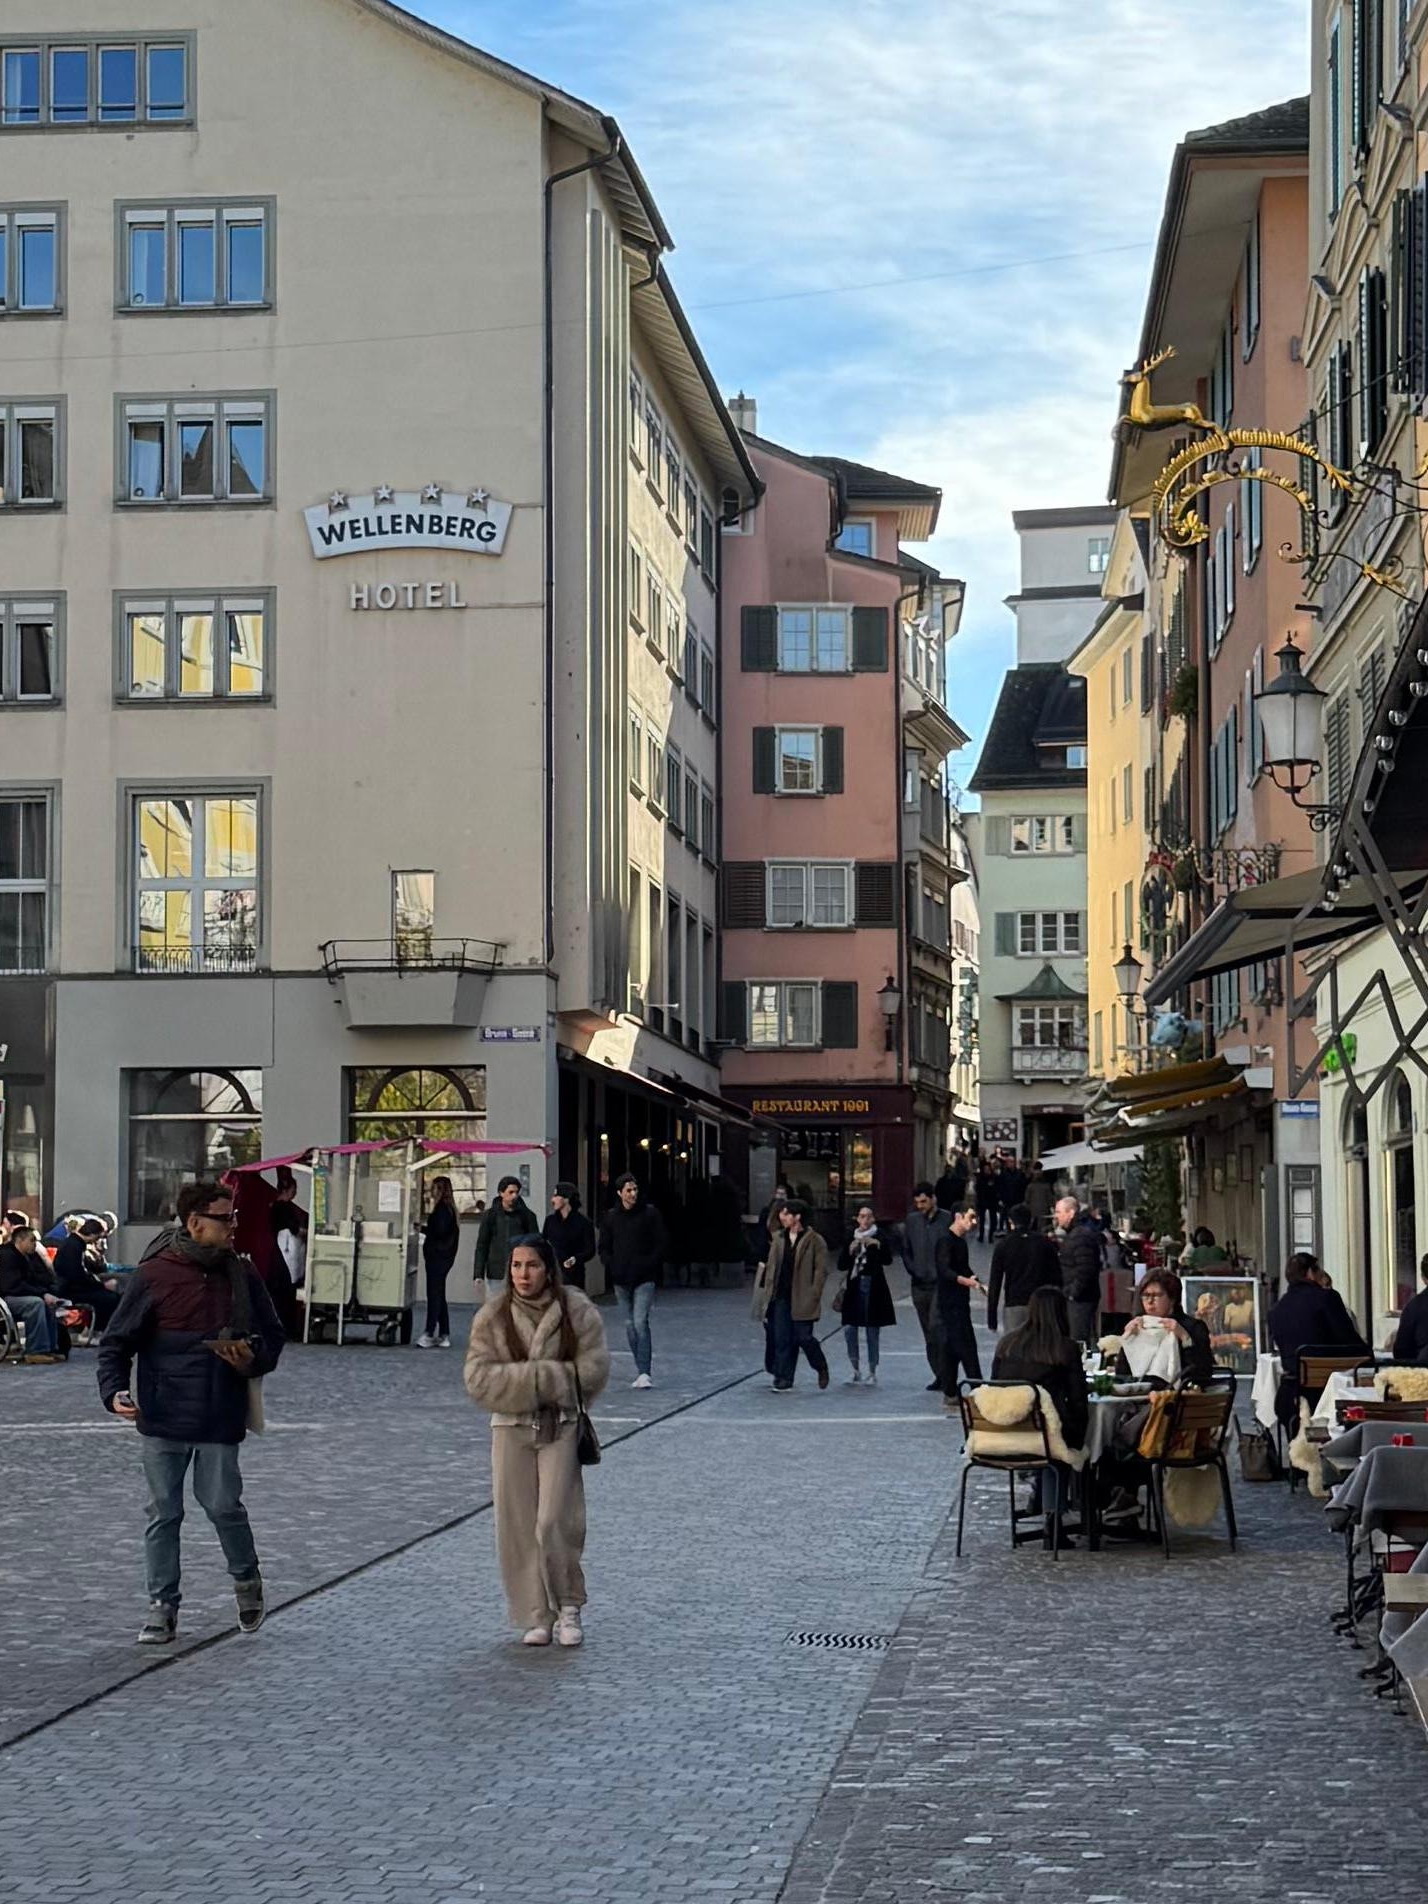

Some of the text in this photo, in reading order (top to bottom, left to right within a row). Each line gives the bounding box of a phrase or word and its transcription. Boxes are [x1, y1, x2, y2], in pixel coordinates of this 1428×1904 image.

[317, 513, 497, 546] WELLENBERG
[349, 580, 468, 610] HOTEL
[751, 1099, 870, 1113] RESTAURANT 1001
